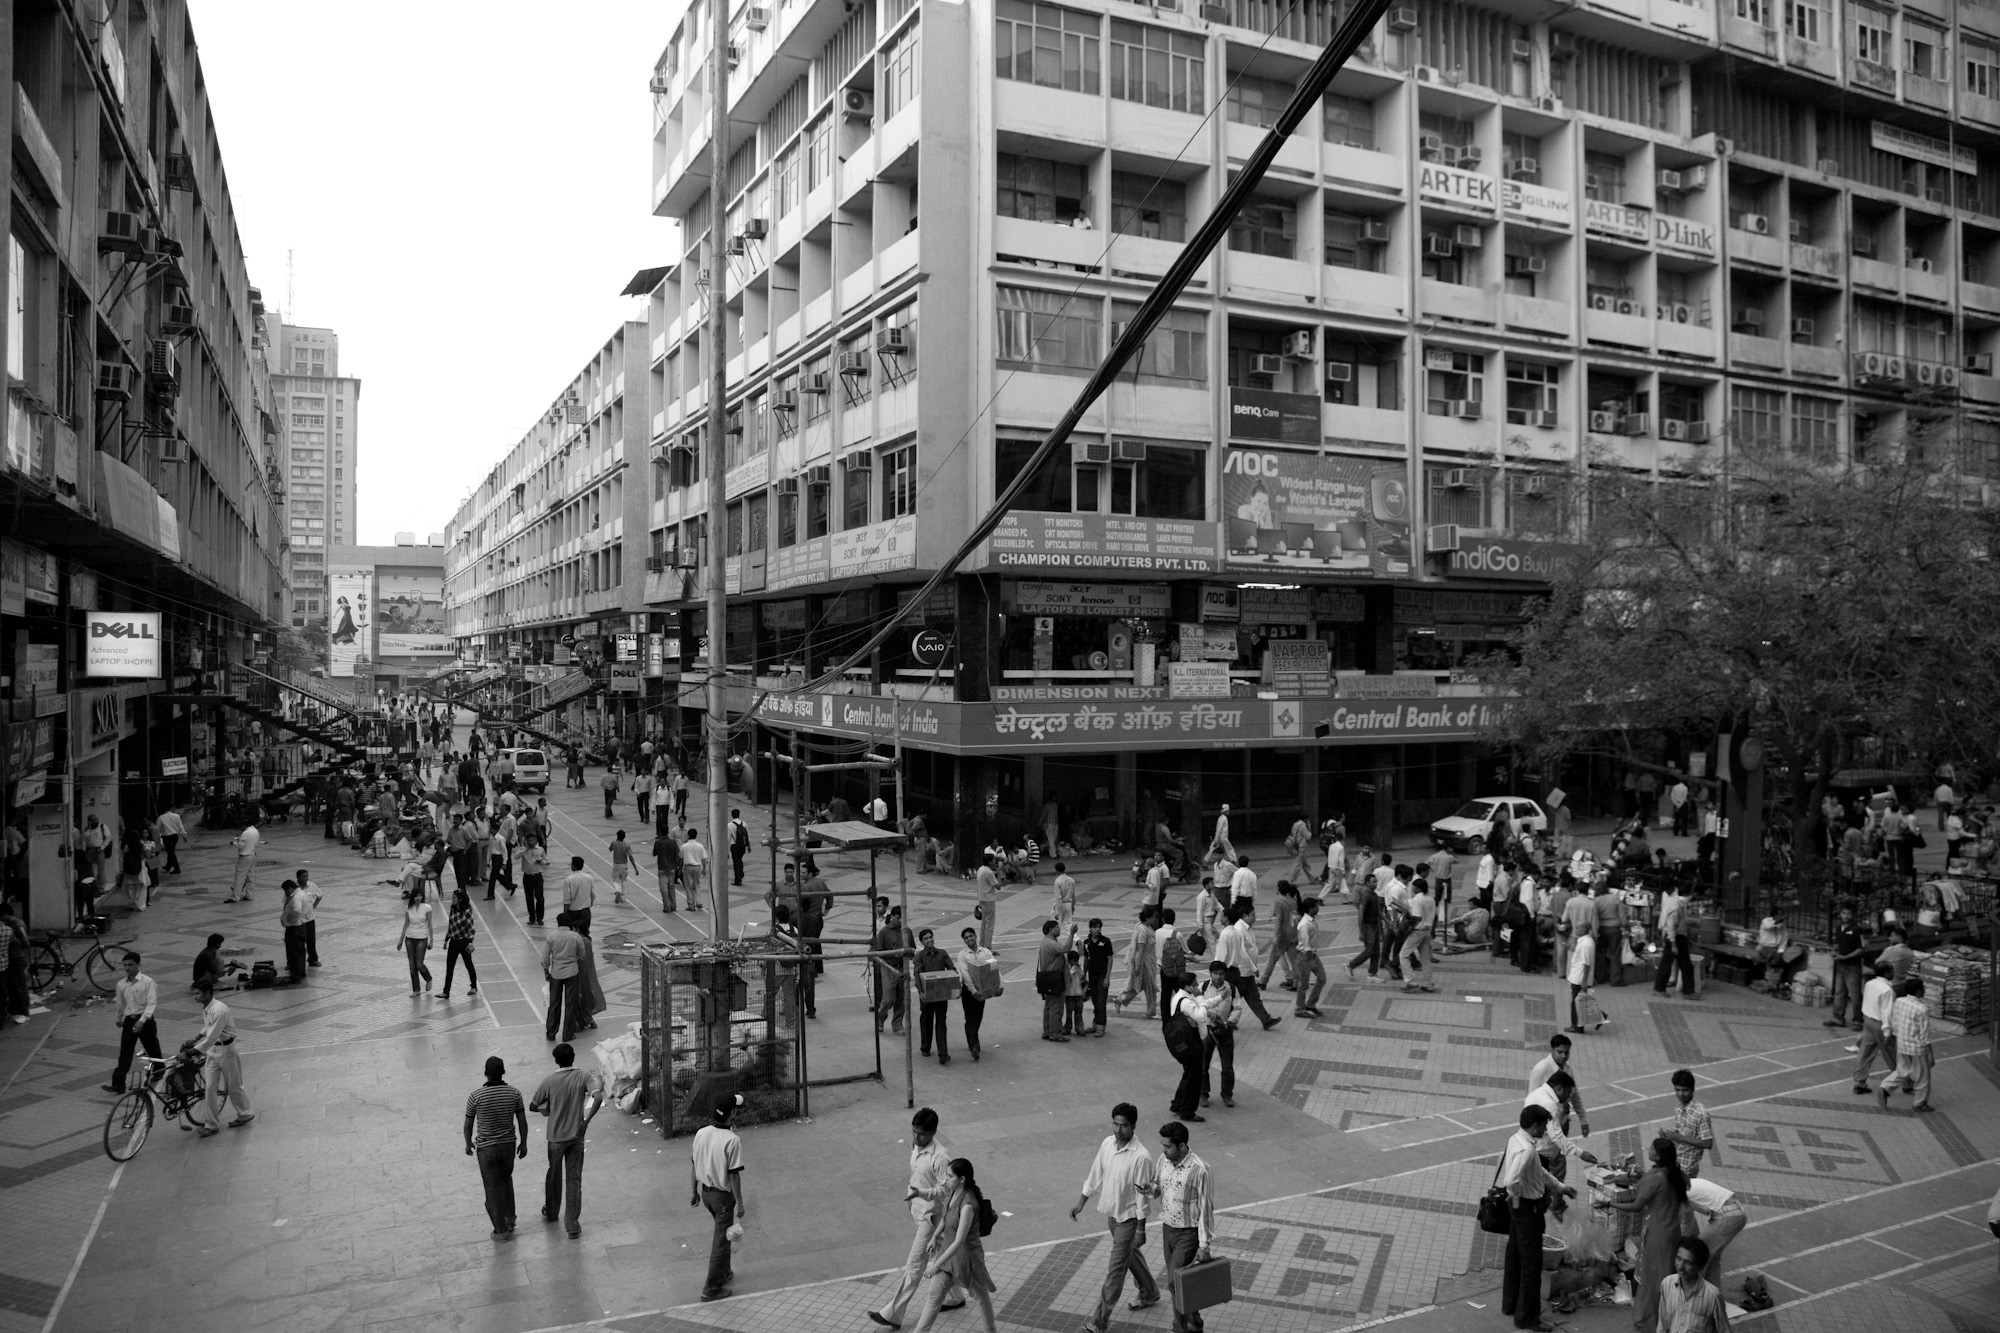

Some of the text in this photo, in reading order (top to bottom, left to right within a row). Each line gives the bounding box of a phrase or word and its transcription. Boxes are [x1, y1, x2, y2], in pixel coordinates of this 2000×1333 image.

[1420, 168, 1493, 202] ARTEK
[1586, 203, 1646, 229] ARTEK
[1656, 218, 1712, 250] D-Link
[1234, 404, 1262, 417] BenQ
[1262, 407, 1280, 418] Care
[1223, 451, 1278, 477] AOC
[1280, 476, 1313, 490] Widest
[1315, 479, 1345, 494] Range
[1289, 491, 1326, 505] World's
[1329, 495, 1365, 510] Largest
[999, 516, 1018, 526] PTOPS
[1044, 518, 1083, 528] TFT MONITORS
[1106, 520, 1121, 529] INTEL
[1124, 521, 1135, 530] AMD
[1136, 522, 1147, 531] CPU
[895, 521, 913, 534] TOSHIBA
[993, 528, 1027, 537] BRANDED PC
[1044, 529, 1084, 538] CRT MONITORS
[1156, 523, 1194, 533] INKJET PRINTERS
[1106, 531, 1147, 541] MOTHERBOARDS
[1156, 534, 1193, 544] LASER PRINTERS
[993, 539, 1034, 548] ASSEMBLED PC
[1045, 540, 1098, 550] OPTICAL DISK DRIVE
[1106, 542, 1149, 552] HARD DISK DRIVE
[844, 547, 858, 560] SONY
[861, 546, 880, 557] lenovo
[1156, 545, 1214, 555] MULTIFUNCTION PRINTERS
[832, 563, 858, 578] LAPTOPS
[864, 559, 890, 573] LOWEST
[891, 555, 912, 569] PRICE
[998, 552, 1210, 571] CHAMPION COMPUTERS PVT. LTD.
[1081, 596, 1114, 604] lenovo
[1205, 592, 1224, 604] AOC
[1243, 590, 1275, 603] LAPTOP
[1278, 591, 1308, 603] REPAIR
[1022, 605, 1073, 614] LAPTOPS
[1087, 607, 1131, 615] LOWEST
[1134, 607, 1165, 616] PRICE
[91, 622, 154, 638] DELL
[918, 643, 944, 652] VAIO
[1271, 643, 1326, 658] LAPTOP
[124, 658, 153, 666] SHOPPE
[1173, 668, 1227, 677] K.L. ITERNATIONAL
[1342, 677, 1392, 689] CYBER
[1397, 677, 1434, 689] CAFE
[996, 687, 1108, 699] DIMENSION
[1114, 687, 1164, 699] NEXT
[843, 702, 873, 726] Central
[912, 708, 939, 734] India
[995, 706, 1070, 740] सेन्ट्रल
[1074, 704, 1117, 730] बैंक
[1179, 703, 1242, 731] इंडिया
[1333, 704, 1402, 730] Central
[1406, 704, 1453, 727] Bank
[1456, 703, 1477, 726] of
